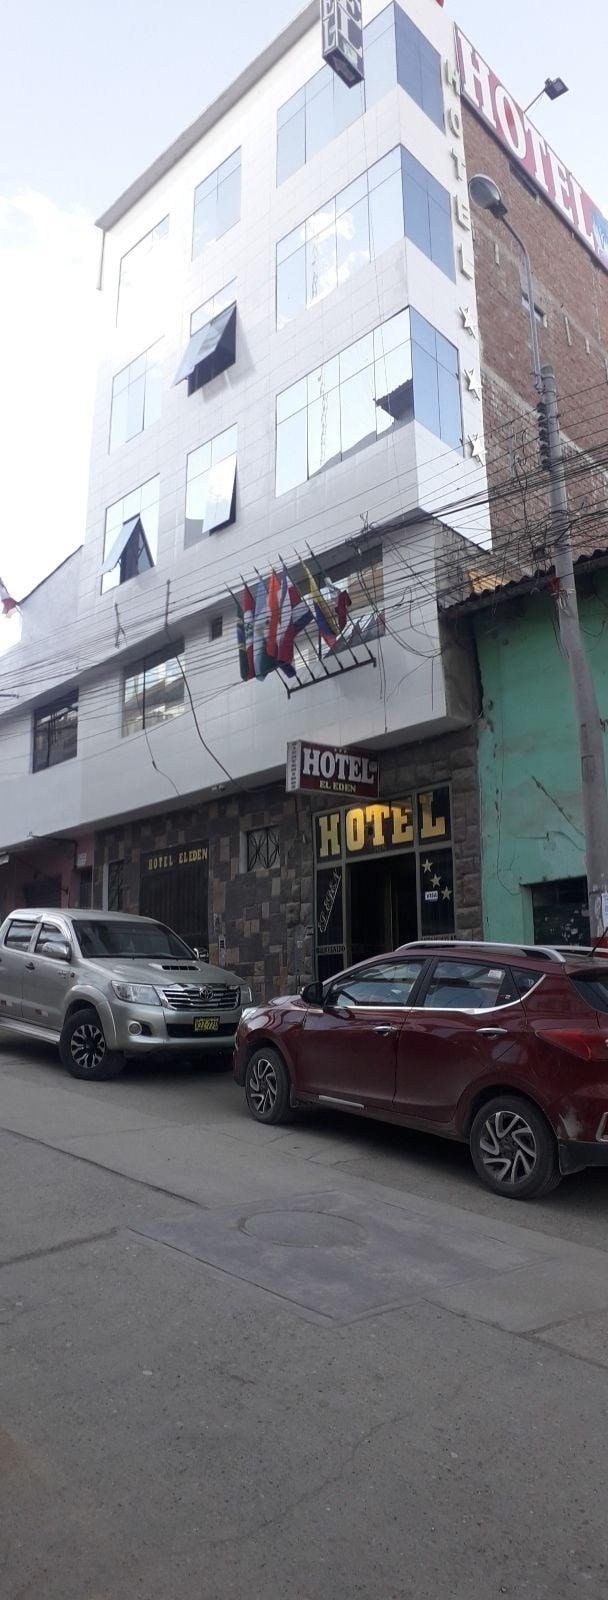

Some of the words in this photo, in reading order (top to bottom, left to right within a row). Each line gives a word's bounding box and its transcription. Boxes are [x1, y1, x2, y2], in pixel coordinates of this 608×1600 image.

[455, 29, 596, 252] HOTEL
[303, 748, 374, 784] HOTEL
[320, 780, 331, 789] EL
[333, 782, 356, 793] EDEN
[319, 792, 446, 857] HOTEL
[148, 855, 173, 870] HOTEL
